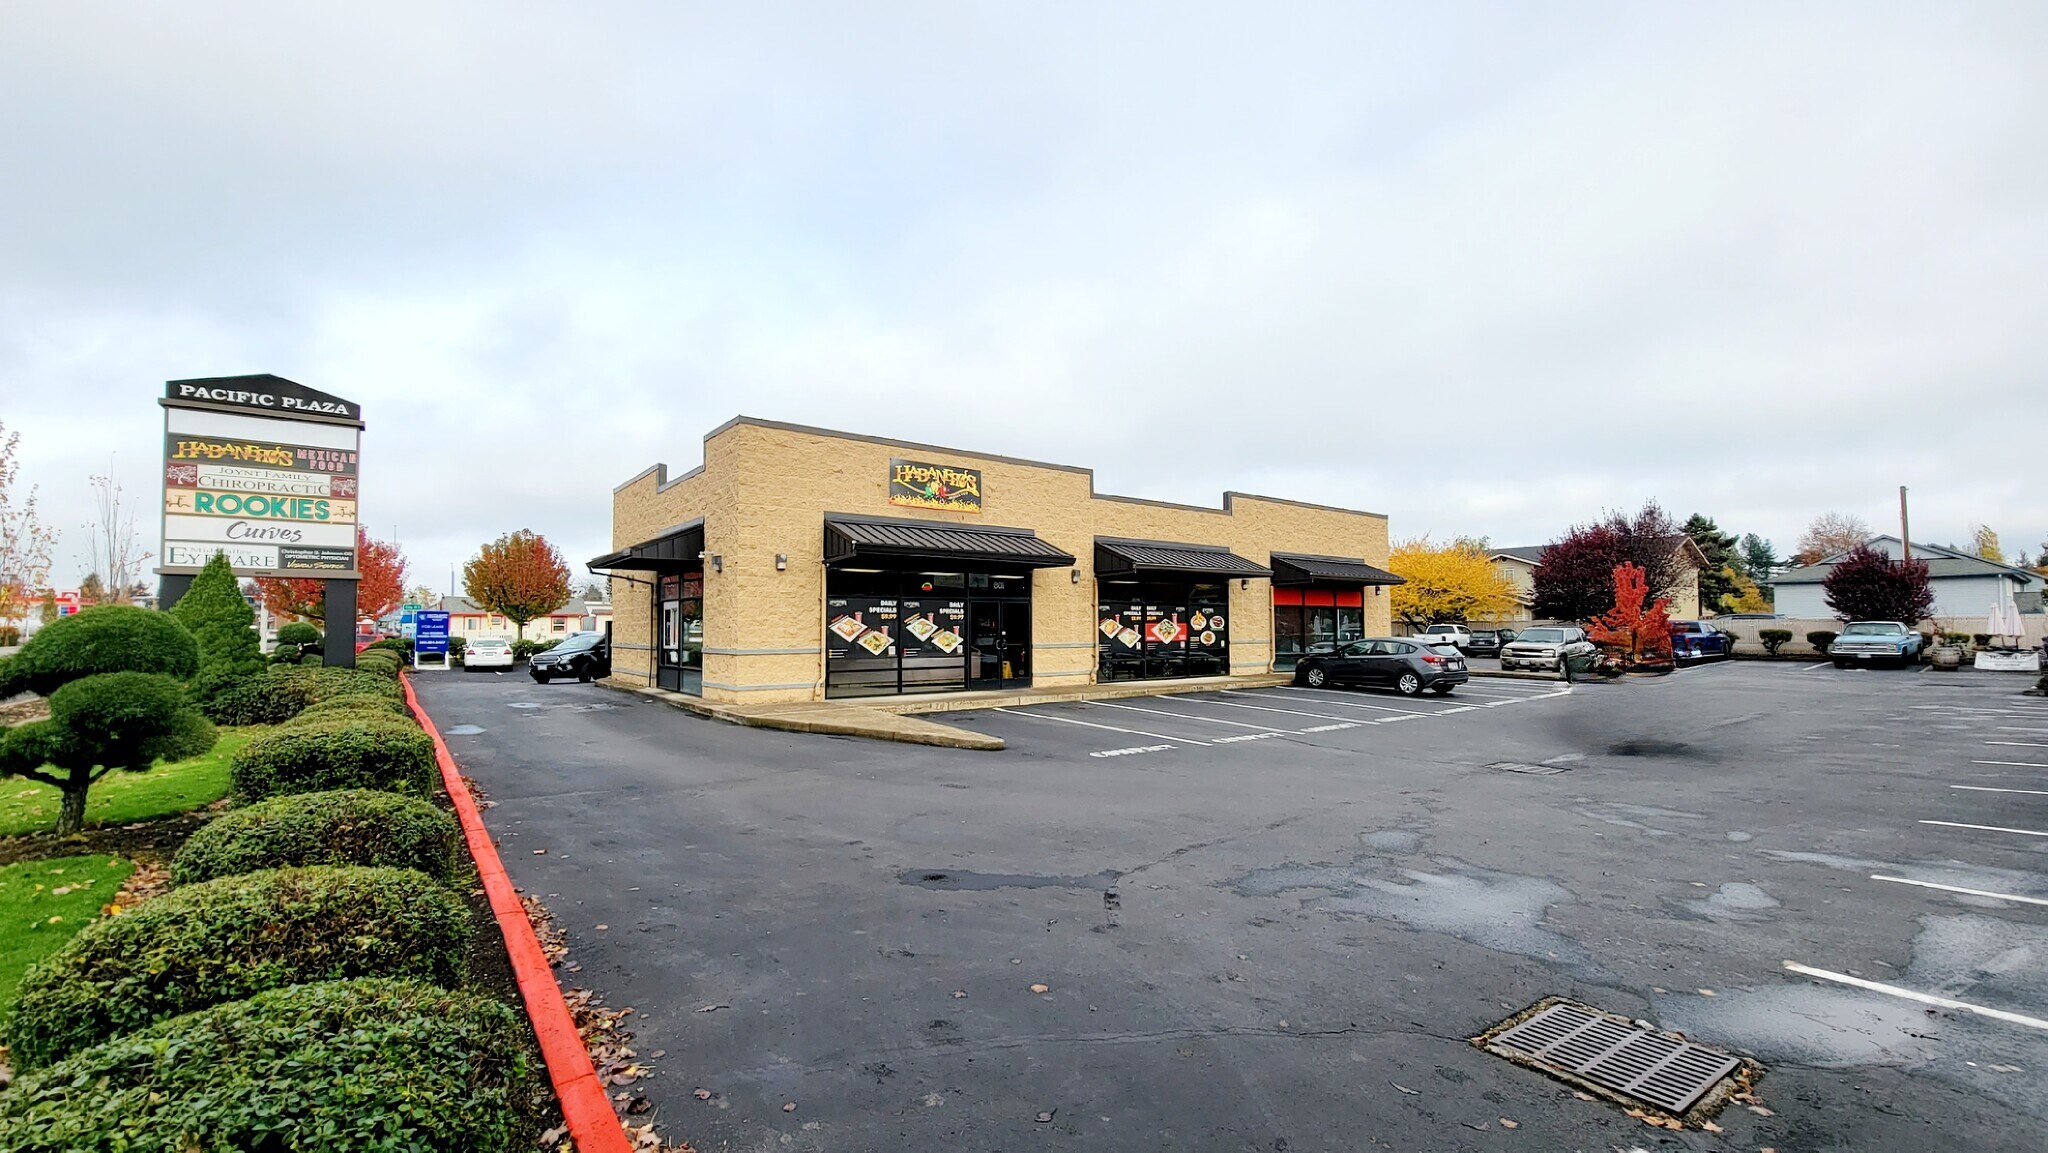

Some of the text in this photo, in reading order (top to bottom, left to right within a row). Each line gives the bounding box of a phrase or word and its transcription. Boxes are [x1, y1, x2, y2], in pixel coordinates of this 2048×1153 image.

[179, 384, 349, 415] PACIFIC PLAZA
[296, 448, 356, 464] MEXICAN
[218, 467, 313, 481] JOYNT FAMILY
[309, 460, 344, 472] FOOD
[198, 476, 330, 496] CHIROPRACTIC
[194, 492, 330, 520] ROOKIES
[225, 521, 303, 543] Curves
[168, 546, 276, 567] EYEARE
[868, 606, 898, 614] SPECIALS
[939, 607, 965, 615] SPECIALS
